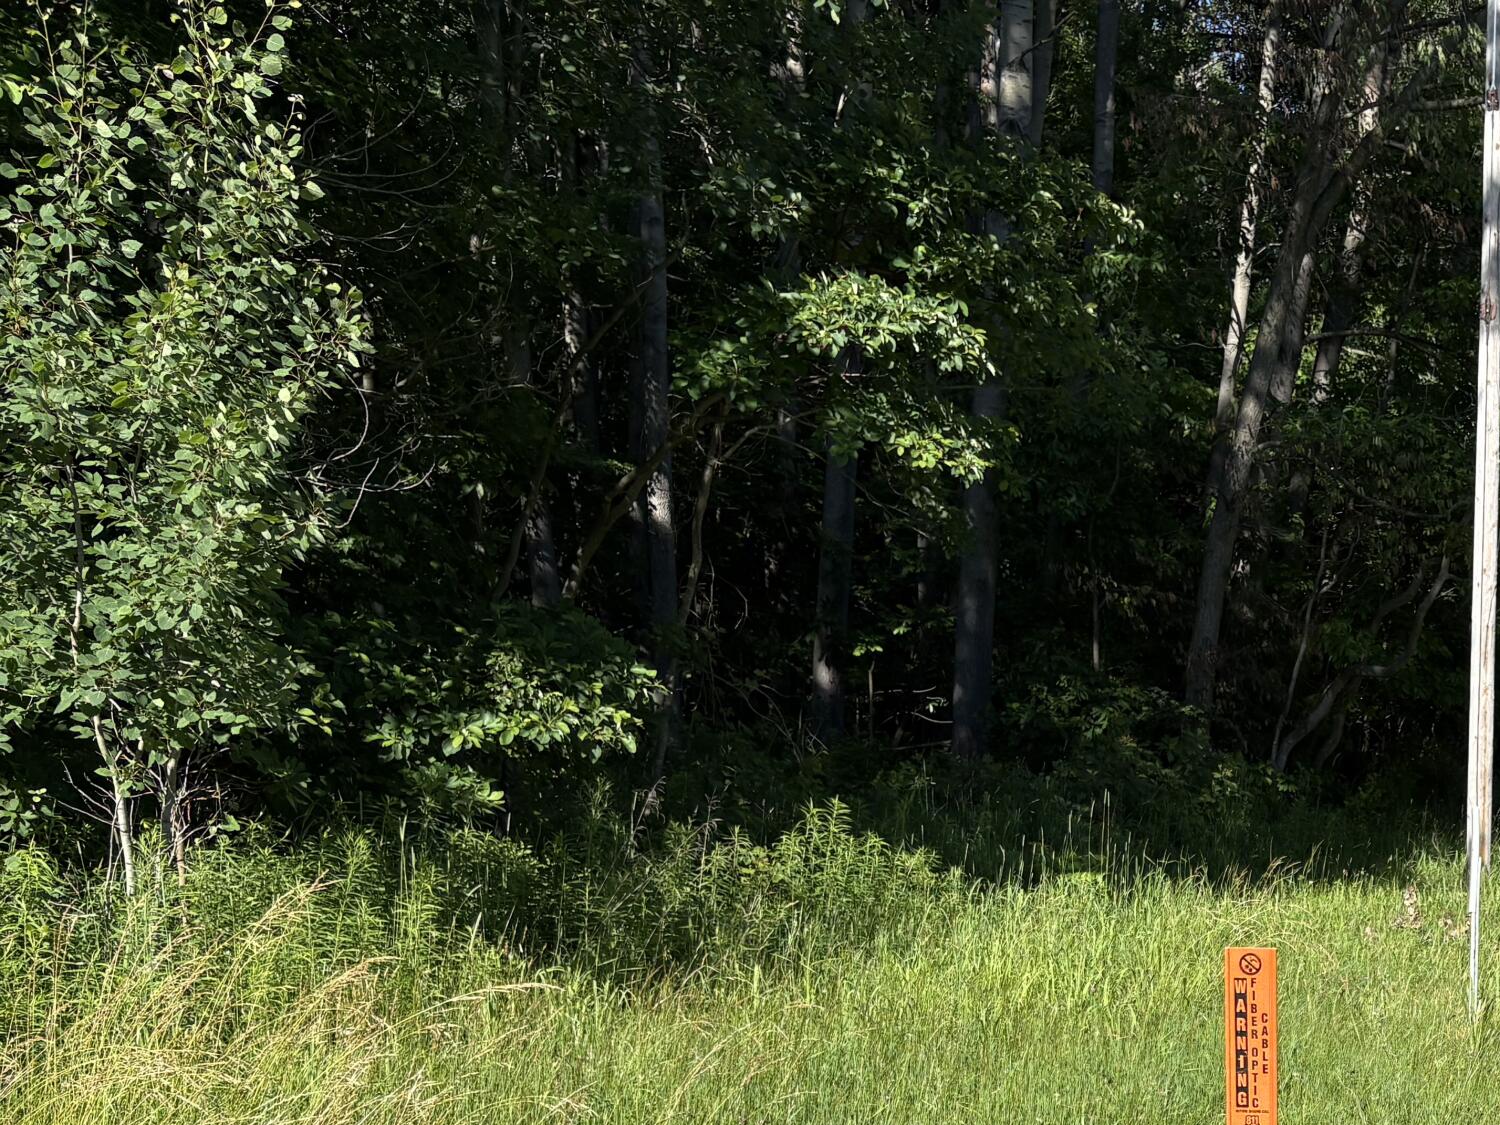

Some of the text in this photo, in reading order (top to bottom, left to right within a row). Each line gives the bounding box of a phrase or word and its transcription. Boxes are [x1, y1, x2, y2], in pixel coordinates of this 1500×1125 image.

[1234, 978, 1248, 1106] WARNING
[1261, 1013, 1269, 1074] CABLE
[1251, 1047, 1259, 1108] OPTIC
